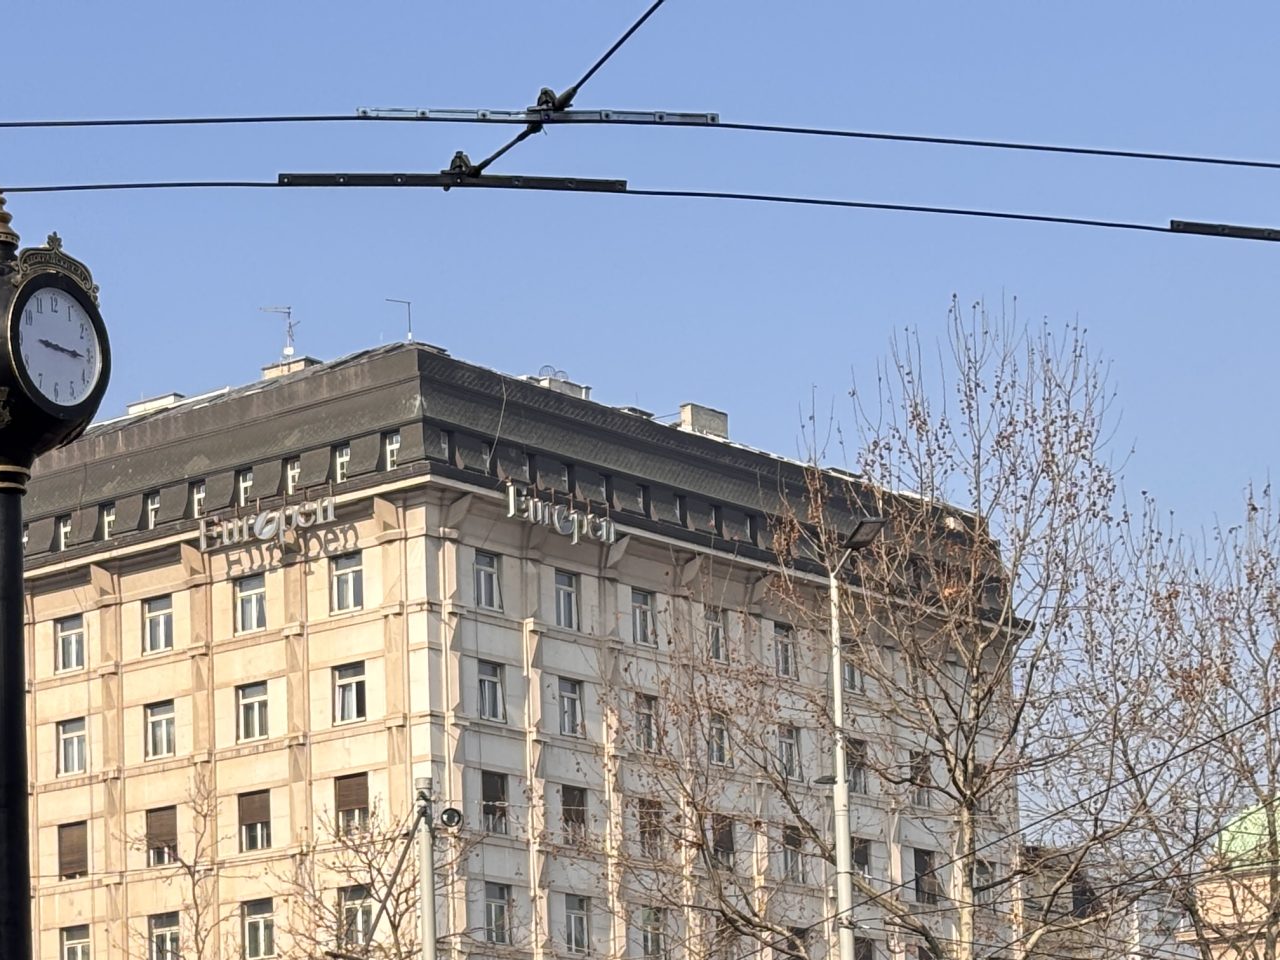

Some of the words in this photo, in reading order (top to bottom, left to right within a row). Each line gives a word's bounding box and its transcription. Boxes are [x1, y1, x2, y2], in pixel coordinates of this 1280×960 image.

[36, 297, 43, 314] 11
[50, 296, 58, 313] 12
[25, 309, 33, 326] 10
